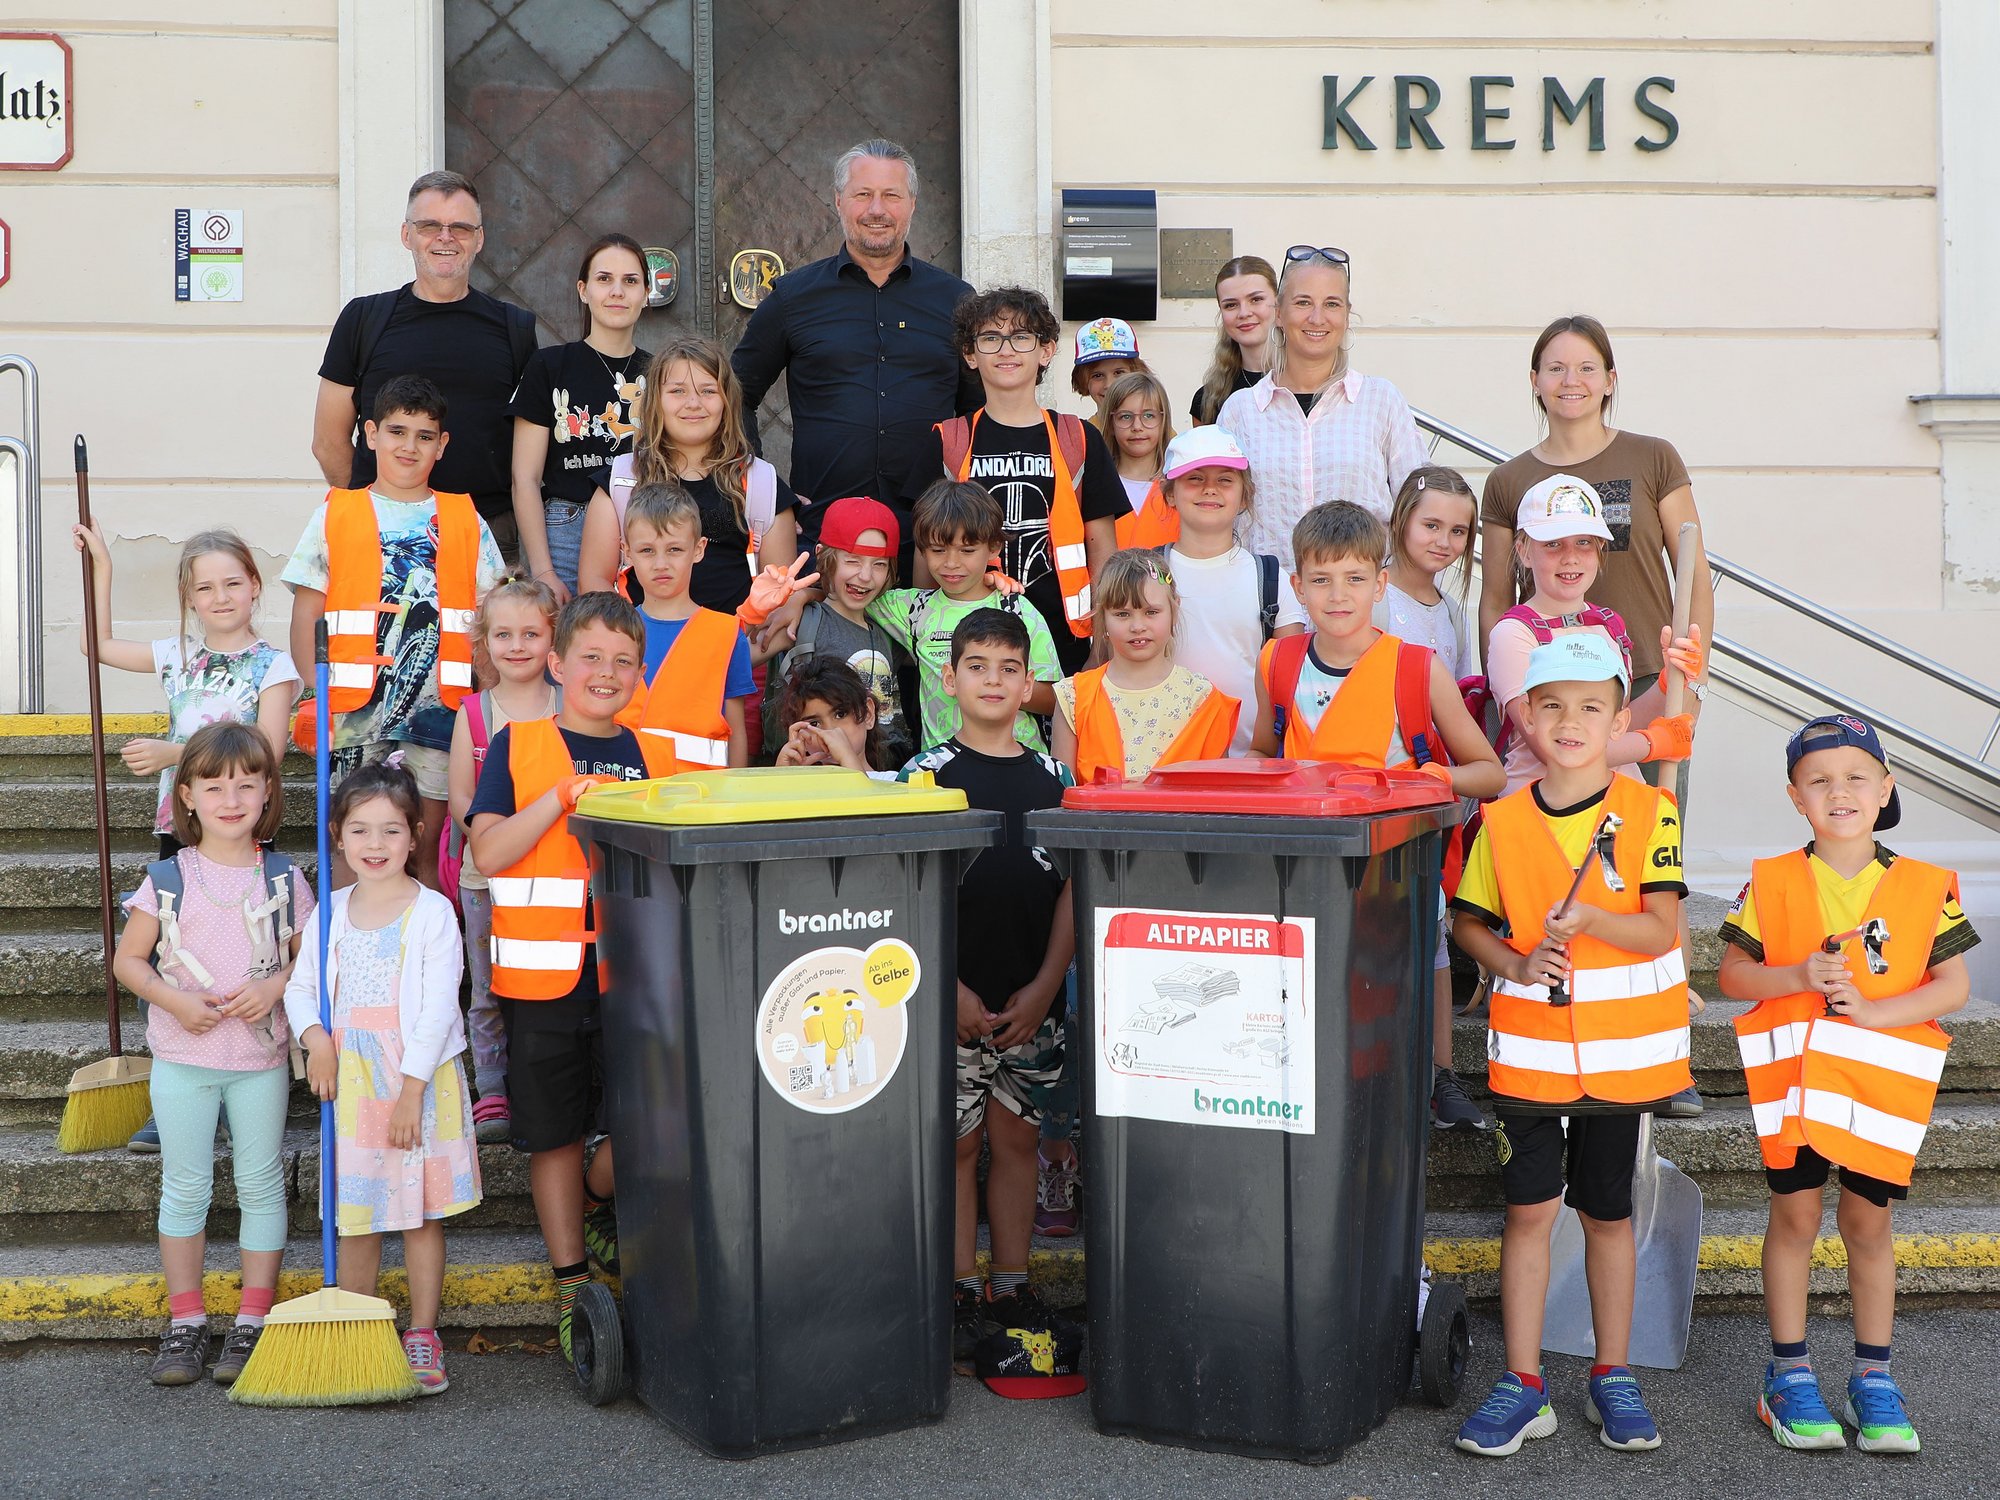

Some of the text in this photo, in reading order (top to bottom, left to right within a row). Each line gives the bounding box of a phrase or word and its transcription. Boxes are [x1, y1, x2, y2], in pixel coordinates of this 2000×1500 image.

[1321, 75, 1680, 153] KREMS
[177, 211, 189, 261] WACHAU
[564, 455, 582, 470] Ich
[583, 454, 603, 468] bin
[969, 457, 1055, 478] ANDALORI
[930, 631, 954, 641] MINE
[778, 908, 894, 936] brantner
[1146, 922, 1271, 949] ALTPAPIER
[868, 959, 894, 974] Ab ins
[872, 967, 910, 986] Gelbe
[768, 968, 808, 1017] Verpackungen
[788, 983, 805, 998] Glas
[804, 972, 819, 985] und
[765, 1018, 774, 1035] Alle
[1194, 1088, 1304, 1121] brantner
